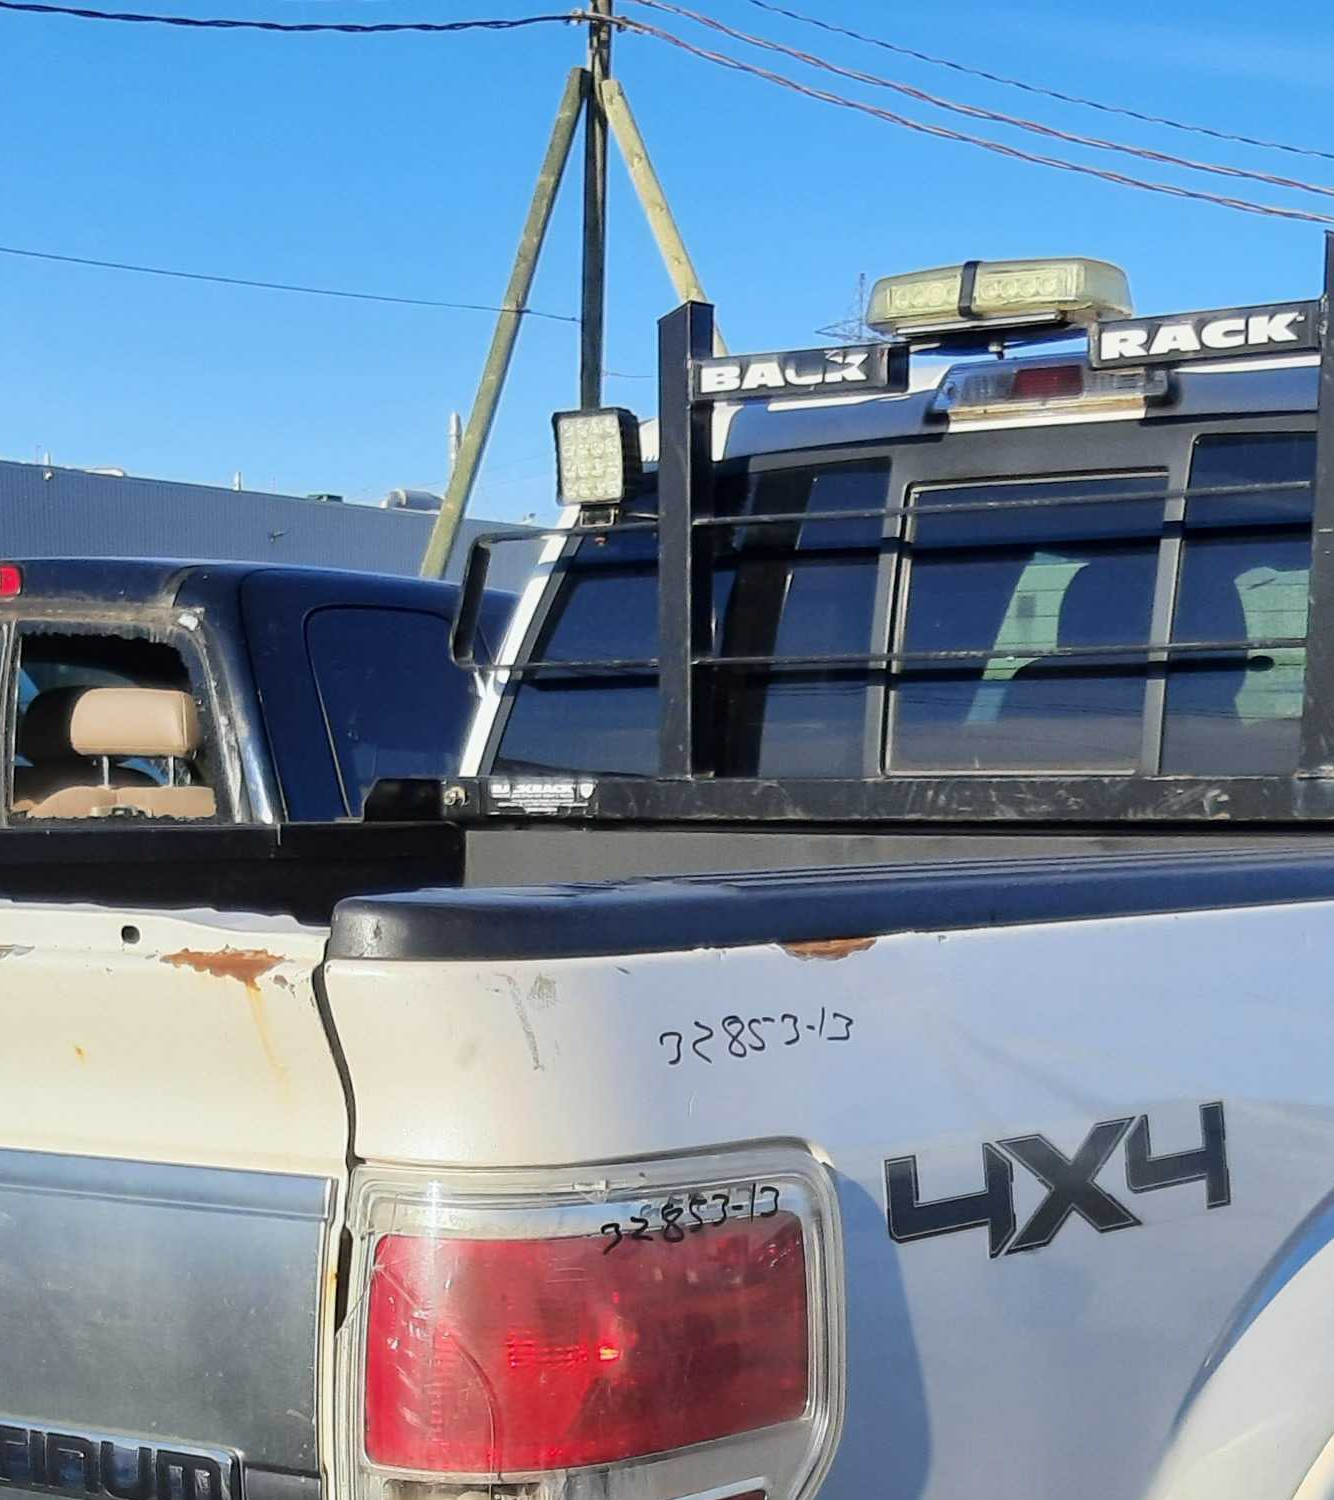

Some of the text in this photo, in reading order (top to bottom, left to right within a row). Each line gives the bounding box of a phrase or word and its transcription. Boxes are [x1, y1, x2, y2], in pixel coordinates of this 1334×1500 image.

[1101, 311, 1299, 361] RACK
[700, 349, 870, 394] BACK
[659, 1006, 855, 1066] 32853-13
[600, 1184, 781, 1254] 32853-13
